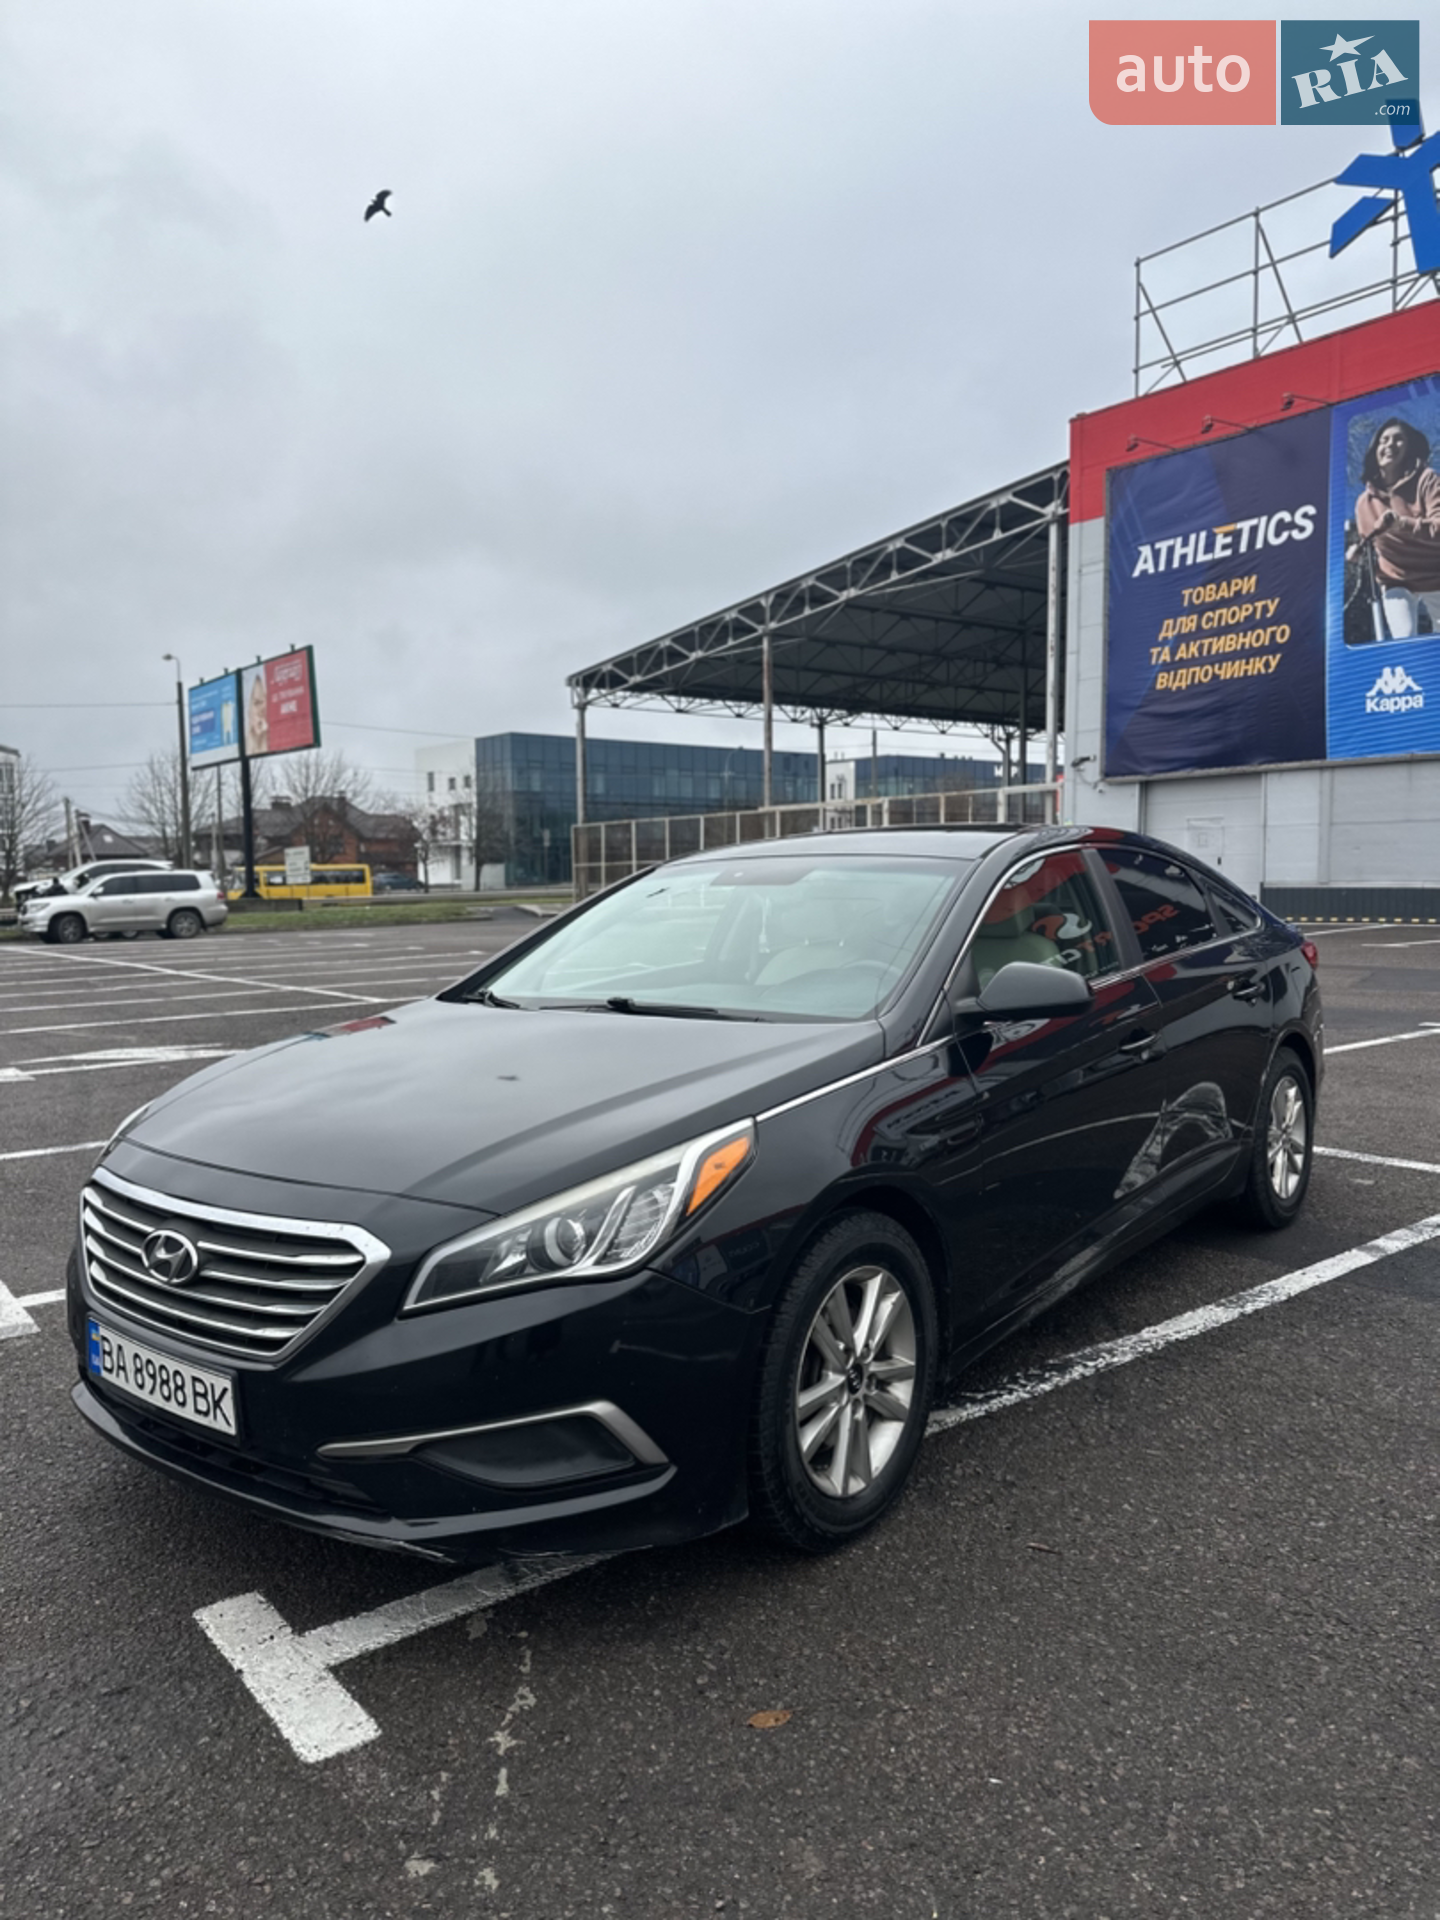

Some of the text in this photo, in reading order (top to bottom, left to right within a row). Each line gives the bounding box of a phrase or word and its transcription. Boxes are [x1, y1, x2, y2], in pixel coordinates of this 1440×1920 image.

[1132, 505, 1317, 578] ATHLETICS
[1181, 574, 1257, 607] ТОВАРИ
[1158, 597, 1280, 641] ДЛЯ СПОРТУ
[1150, 624, 1291, 665] ТА АКТИВНОГО
[1155, 653, 1282, 691] ВІДПОЧИНКУ
[1366, 694, 1423, 714] Kappa
[101, 1335, 232, 1428] BA 8988 BK
